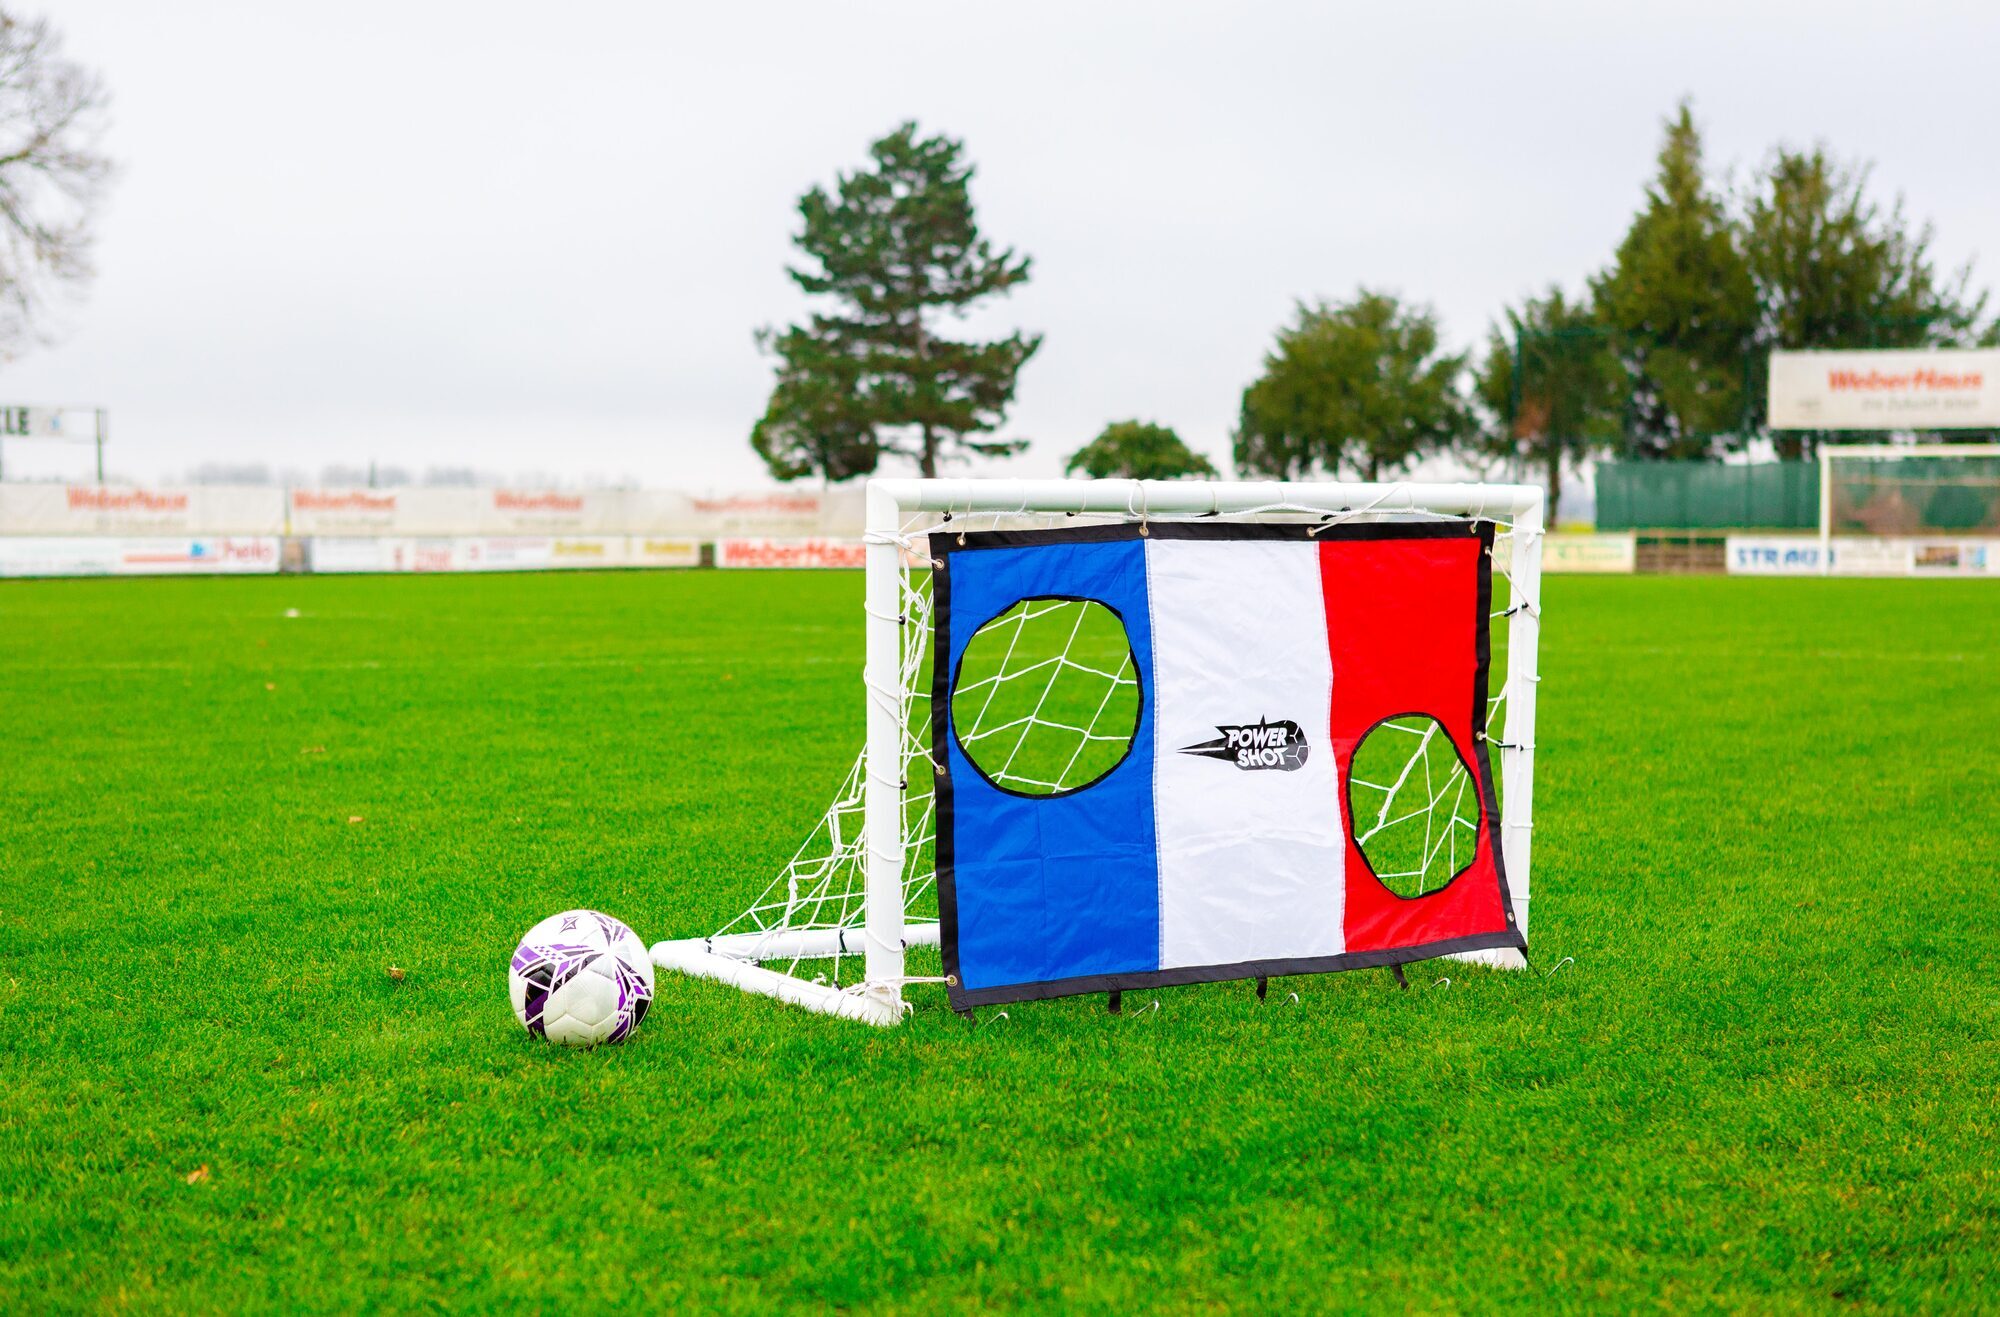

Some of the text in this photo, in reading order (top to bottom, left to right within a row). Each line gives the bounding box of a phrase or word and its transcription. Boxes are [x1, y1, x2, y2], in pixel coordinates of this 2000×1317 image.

[0, 407, 29, 435] LE
[1225, 727, 1288, 748] POWER
[1237, 747, 1289, 767] SHOT
